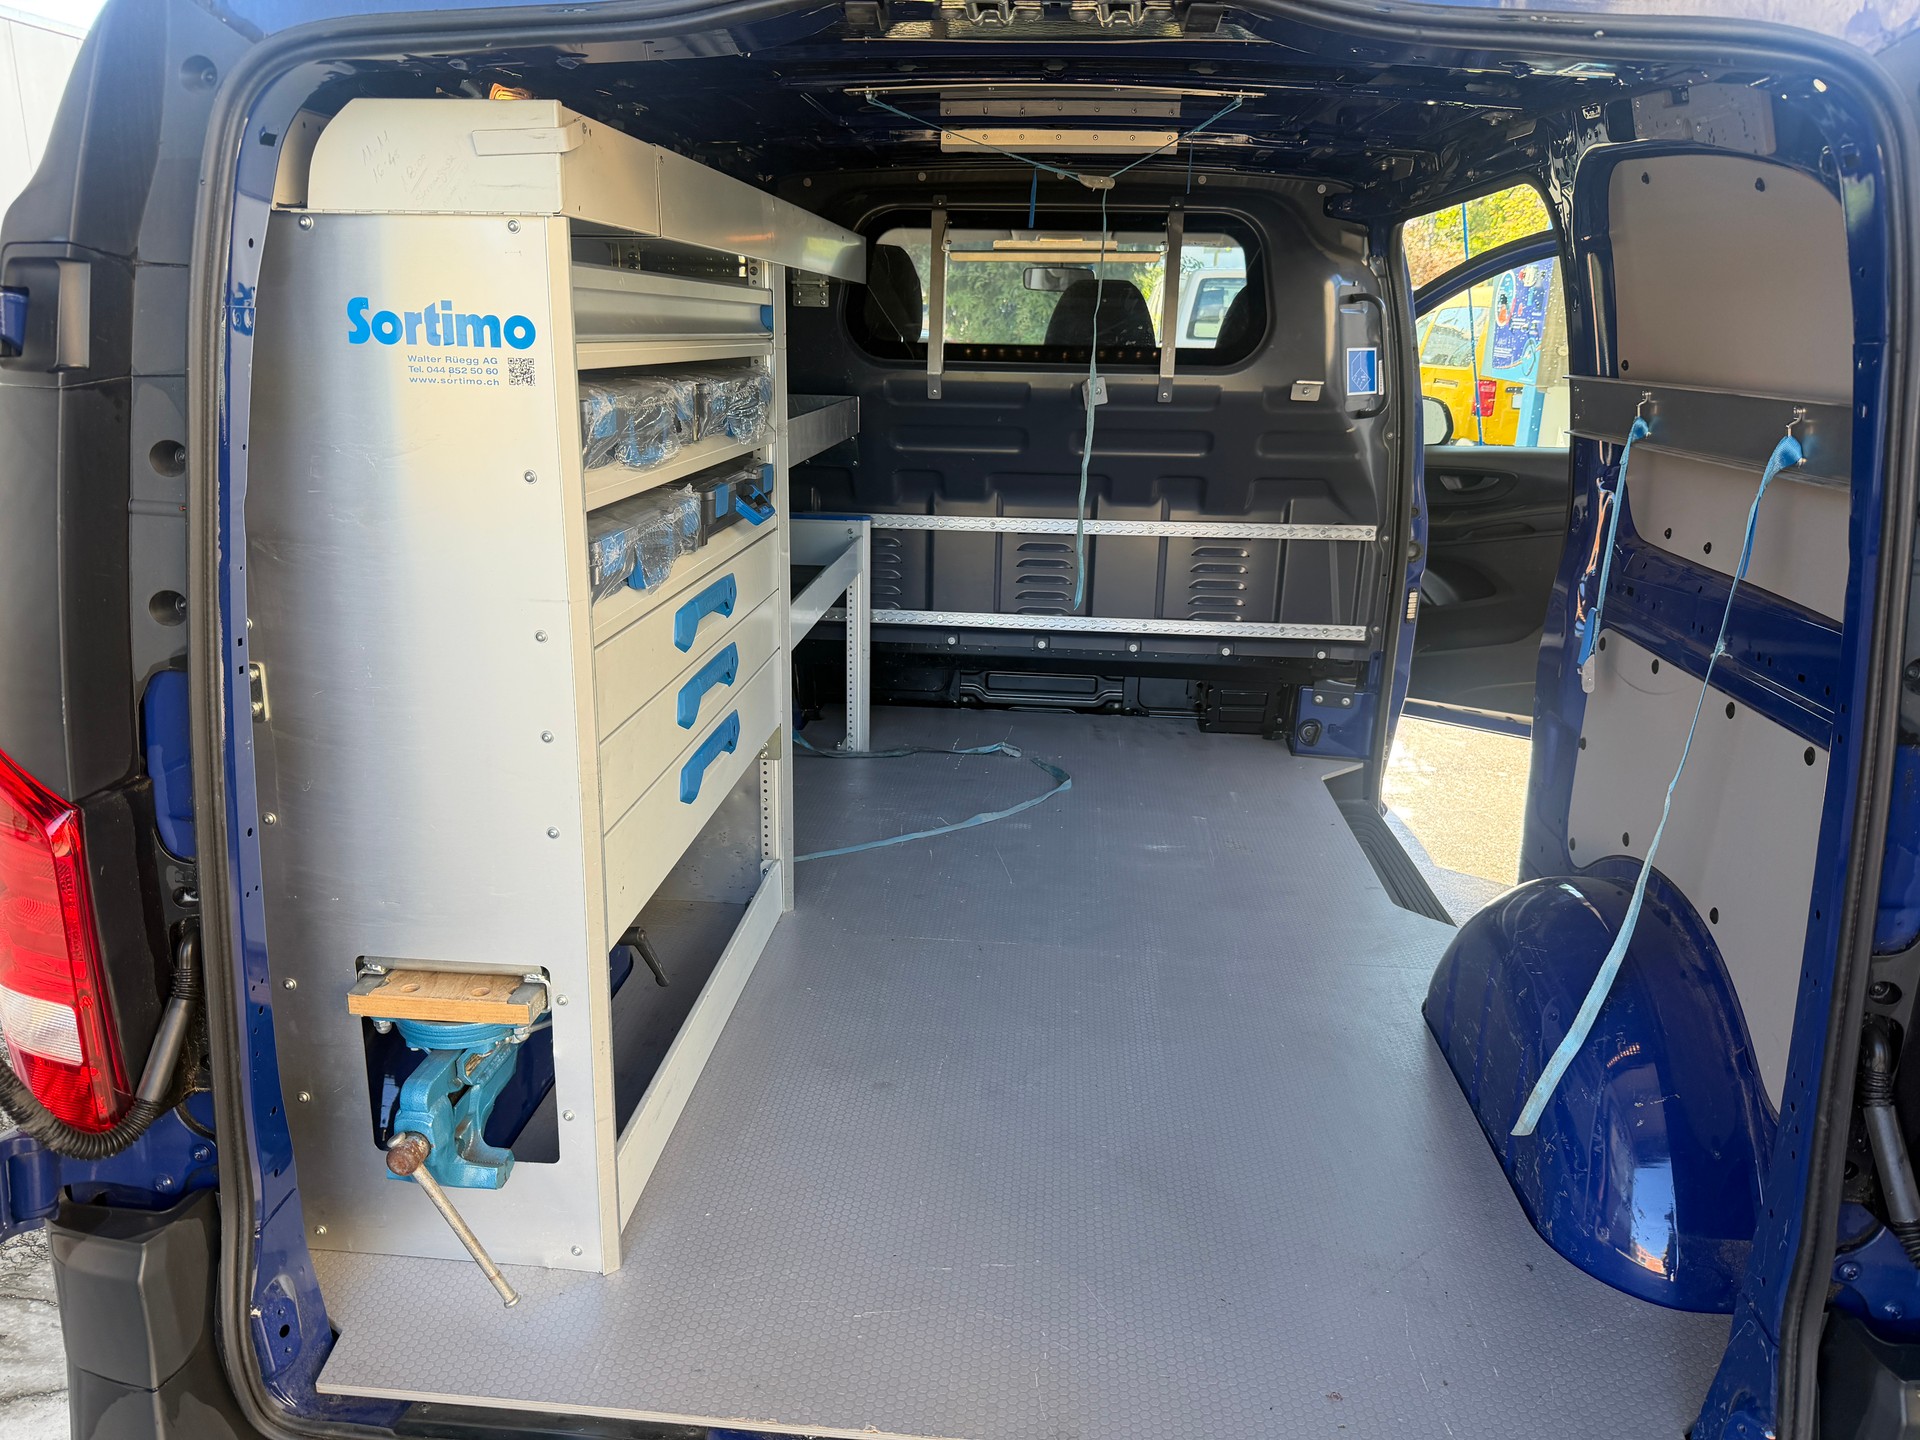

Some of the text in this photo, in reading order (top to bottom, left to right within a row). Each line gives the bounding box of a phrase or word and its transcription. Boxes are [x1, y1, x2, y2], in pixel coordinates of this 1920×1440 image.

[347, 296, 536, 350] Sortimo
[407, 354, 498, 366] Walter Rüegg AG
[408, 365, 424, 373] Tel.
[426, 366, 446, 374] 044
[448, 367, 468, 375] 852
[470, 367, 483, 375] 50
[408, 376, 500, 386] www.sortimo.ch
